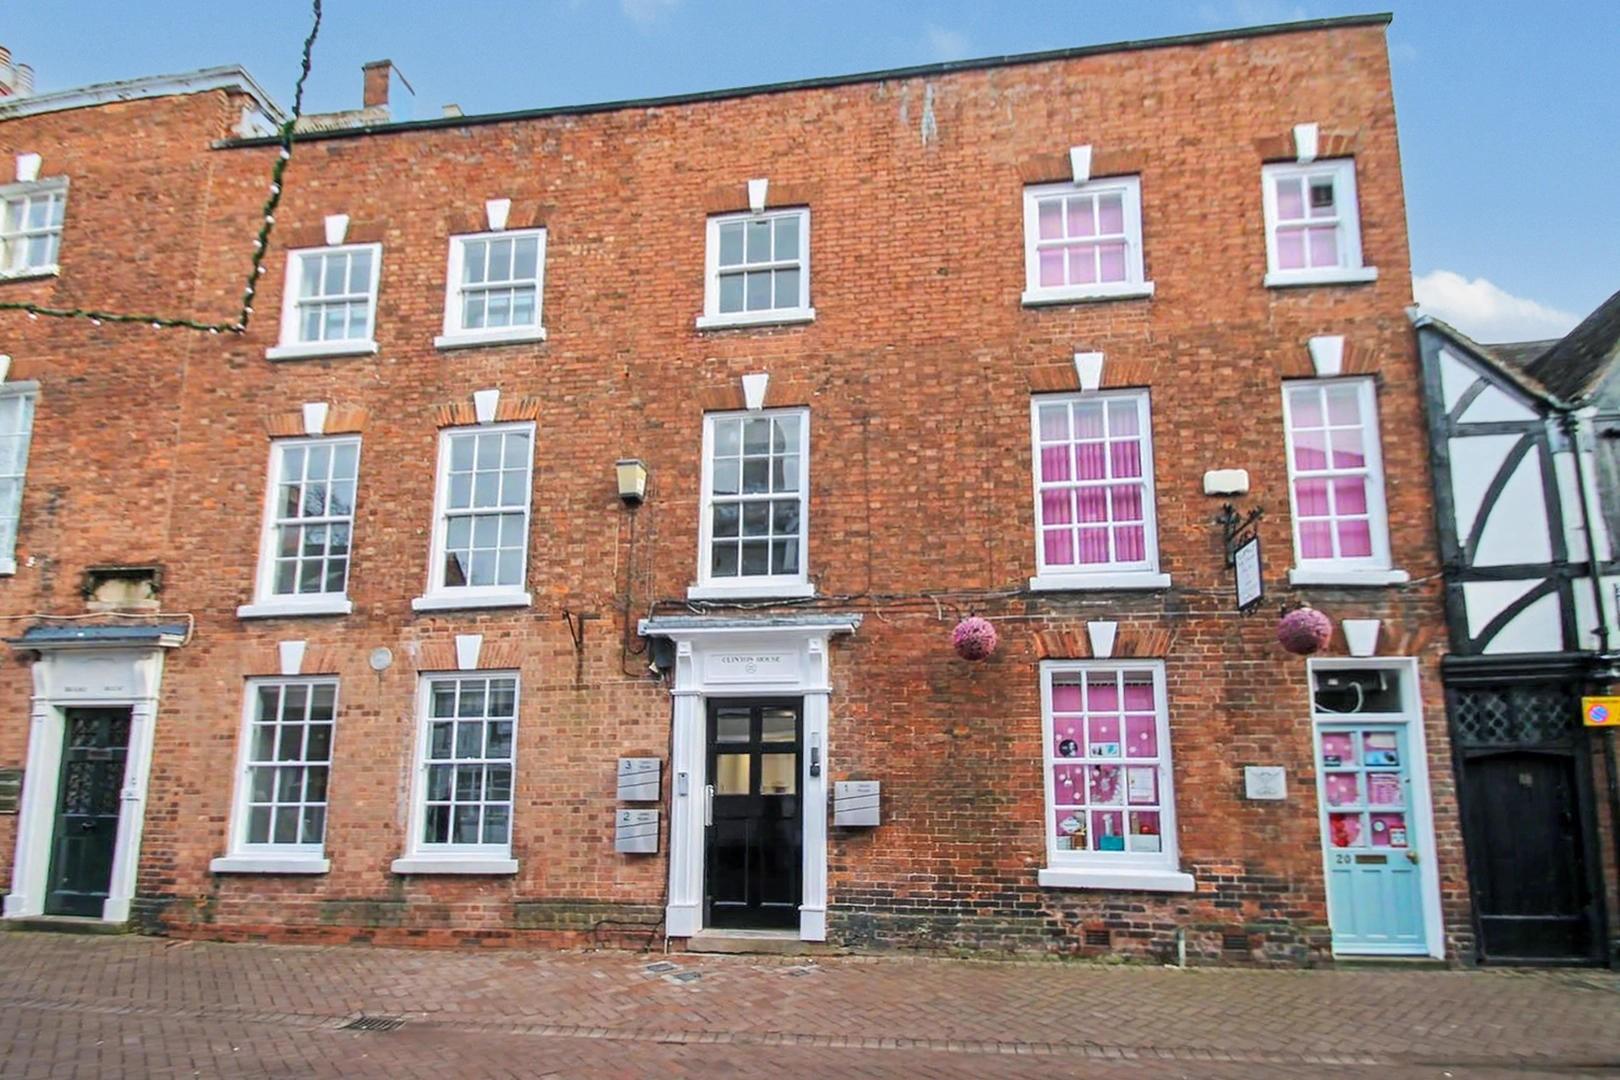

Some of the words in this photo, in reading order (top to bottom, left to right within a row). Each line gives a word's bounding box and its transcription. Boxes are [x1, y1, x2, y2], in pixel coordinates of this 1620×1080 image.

[624, 760, 632, 770] 3
[623, 811, 631, 821] 2
[1335, 853, 1351, 865] 20
